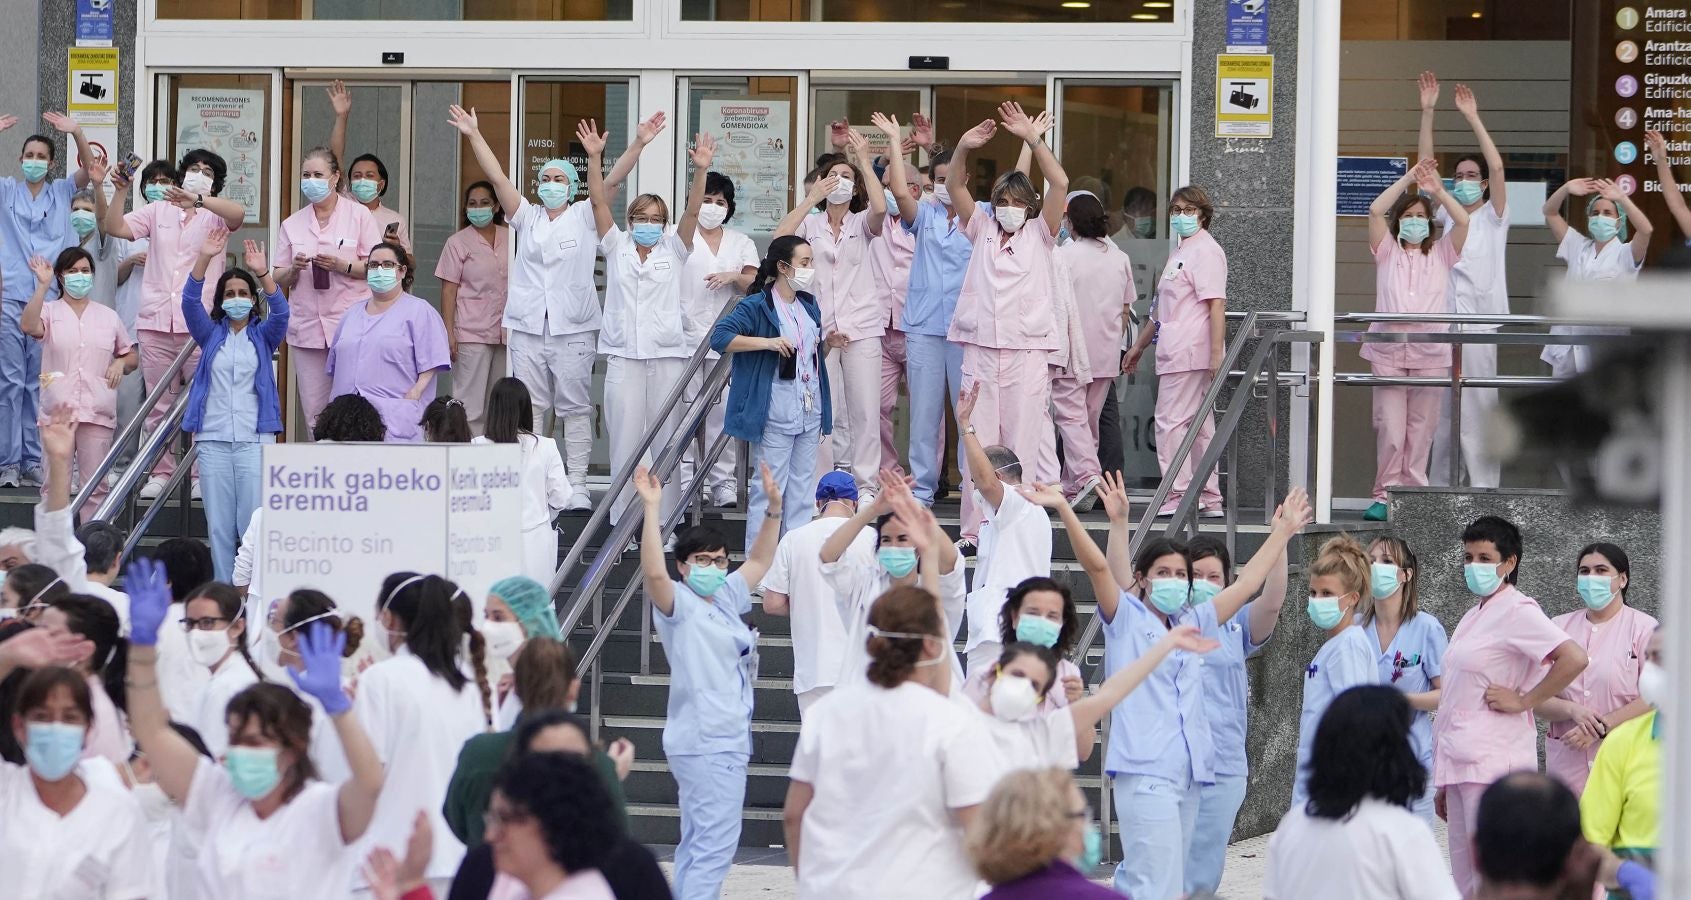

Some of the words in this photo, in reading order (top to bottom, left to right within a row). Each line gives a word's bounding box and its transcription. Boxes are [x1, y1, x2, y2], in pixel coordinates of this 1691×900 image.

[1644, 6, 1687, 18] Amara
[1620, 44, 1633, 60] 2
[1620, 78, 1632, 94] 3
[1619, 110, 1633, 127] 4
[527, 139, 555, 148] AVISO:
[1620, 144, 1631, 161] 5
[1619, 177, 1631, 193] 6
[269, 465, 335, 489] Kerik
[345, 467, 441, 495] gabeko
[451, 467, 478, 490] Kerik
[481, 465, 519, 495] gabeko
[269, 492, 368, 512] eremua
[451, 495, 491, 512] eremua
[268, 530, 353, 553] Recinto
[361, 532, 393, 554] sin
[267, 554, 333, 575] humo
